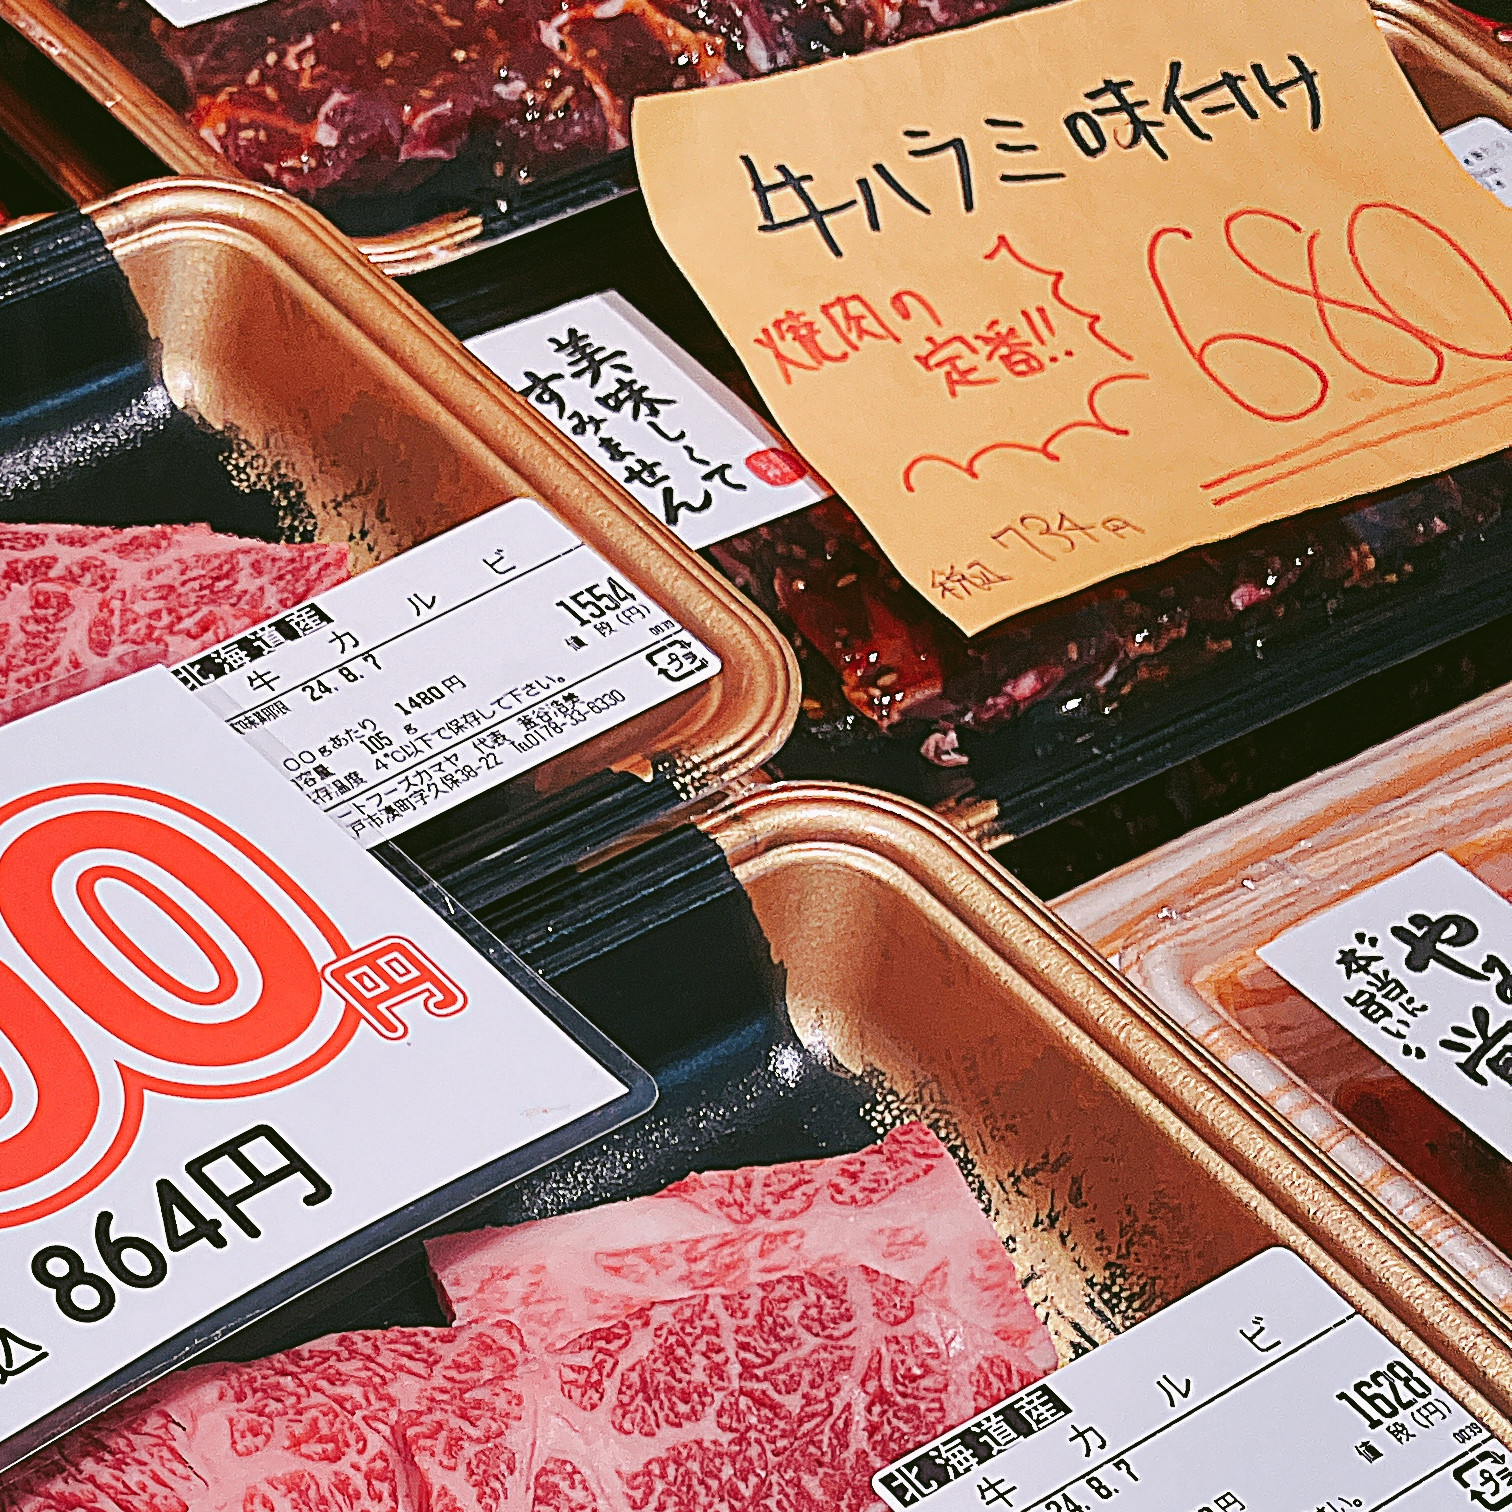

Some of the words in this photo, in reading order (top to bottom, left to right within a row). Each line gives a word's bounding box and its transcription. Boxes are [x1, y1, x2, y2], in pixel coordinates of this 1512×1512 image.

[754, 289, 942, 383] 焼肉の
[519, 371, 713, 526] すみません
[556, 576, 636, 626] 1554
[306, 771, 368, 804] 存温度
[31, 1124, 332, 1322] 864円
[890, 1386, 1066, 1505] 北海道産
[977, 1316, 1281, 1509] 牛カルビ
[1336, 1360, 1431, 1429] 1628
